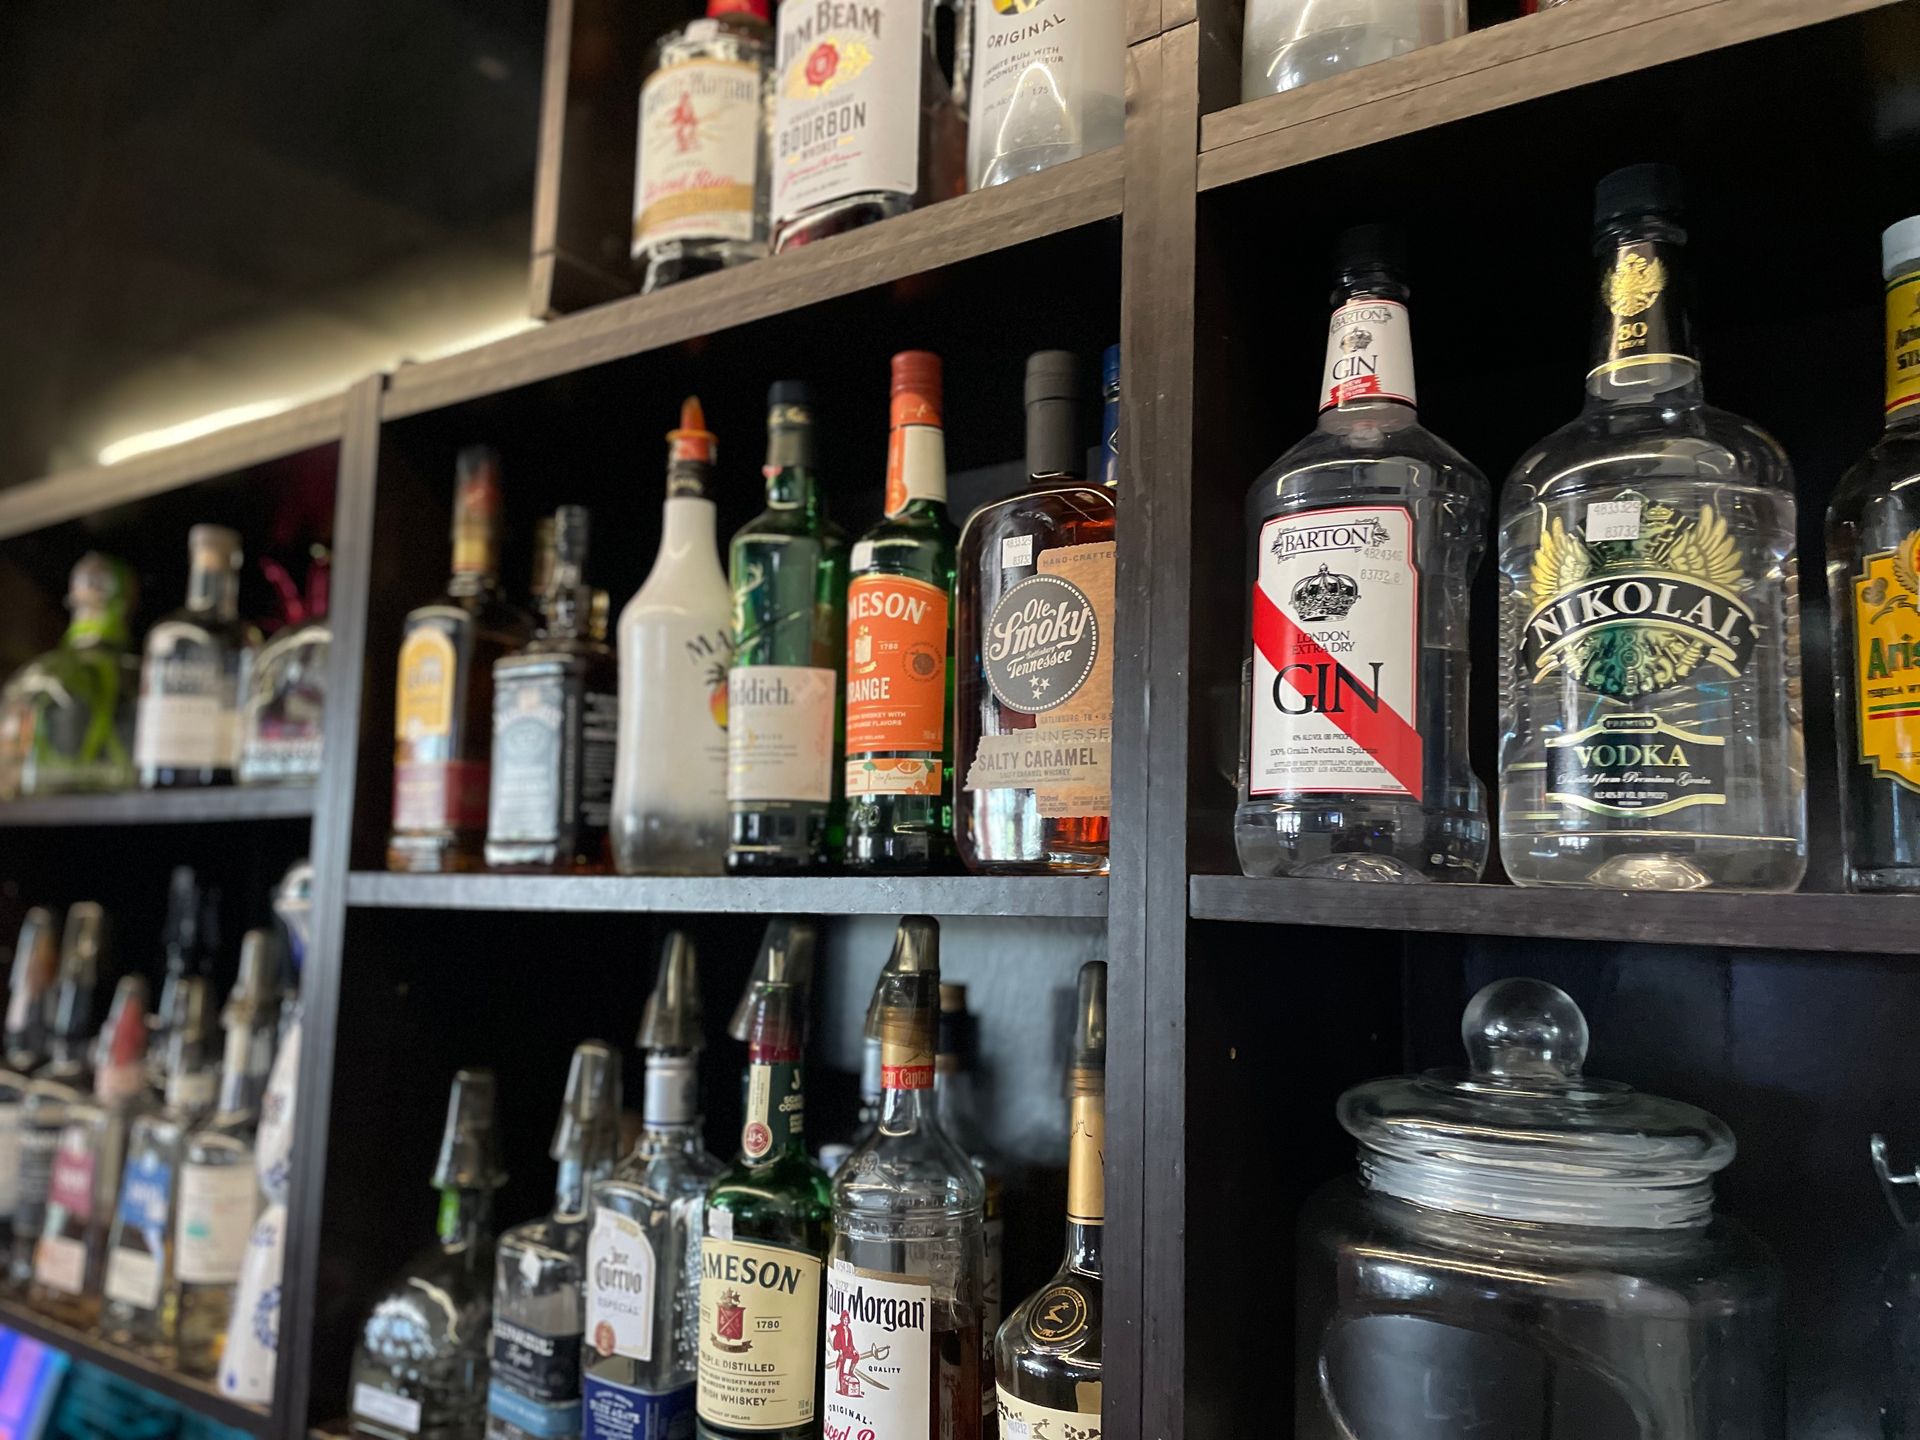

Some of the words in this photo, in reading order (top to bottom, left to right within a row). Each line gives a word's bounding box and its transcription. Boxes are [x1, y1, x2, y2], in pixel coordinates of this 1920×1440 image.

[816, 0, 882, 40] BEAM
[987, 13, 1066, 49] ORIGINAL
[1010, 51, 1031, 63] RUM
[1033, 46, 1060, 56] WITH
[780, 102, 867, 158] BOURBON
[1618, 321, 1649, 341] 80
[1332, 355, 1379, 381] GIN
[1284, 527, 1372, 552] BARTON
[1604, 525, 1639, 538] 83732
[1023, 598, 1056, 624] Ole
[1531, 581, 1743, 648] NIKOLAI
[989, 601, 1092, 662] Smoky
[1297, 630, 1351, 645] LONDON
[1292, 640, 1329, 656] EXTRA
[1330, 640, 1356, 653] DRY
[1007, 649, 1073, 679] Tennessee
[1272, 661, 1385, 716] GIN
[978, 752, 1019, 773] SALTY
[1024, 748, 1099, 769] CARAMEL
[1310, 745, 1345, 755] Neutral
[1573, 743, 1691, 769] VODKA
[1622, 771, 1675, 785] Premium
[594, 1257, 643, 1295] Cuervo
[848, 1287, 925, 1332] Morgan
[756, 1320, 780, 1329] 1780
[722, 1362, 775, 1373] DISTILLED
[868, 1365, 901, 1374] QUALITY
[720, 1393, 768, 1407] WHISKEY
